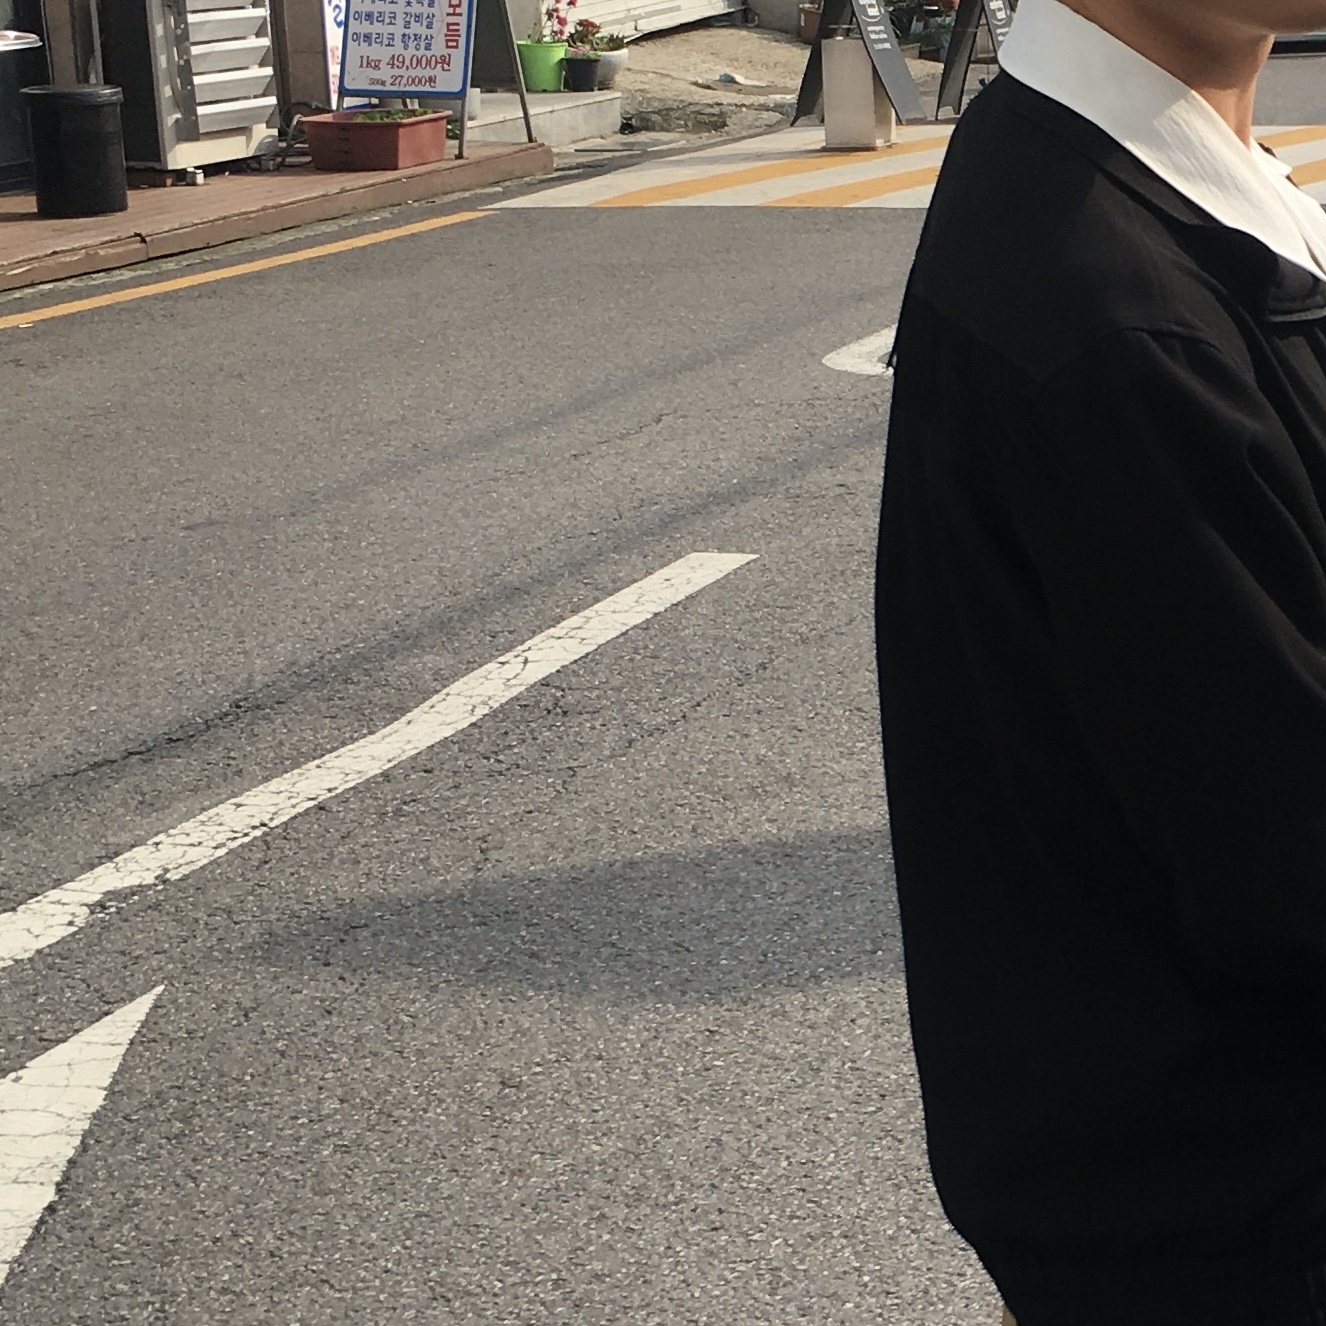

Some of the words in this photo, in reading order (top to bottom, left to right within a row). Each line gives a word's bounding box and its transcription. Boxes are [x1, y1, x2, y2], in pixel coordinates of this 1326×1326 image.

[353, 10, 397, 26] 이베리코
[402, 11, 436, 30] 갈비살
[351, 31, 395, 48] 이베리코
[400, 32, 434, 52] 항정살
[358, 55, 383, 71] 1kg
[386, 53, 452, 72] 49,000원
[390, 74, 437, 88] 27,000원
